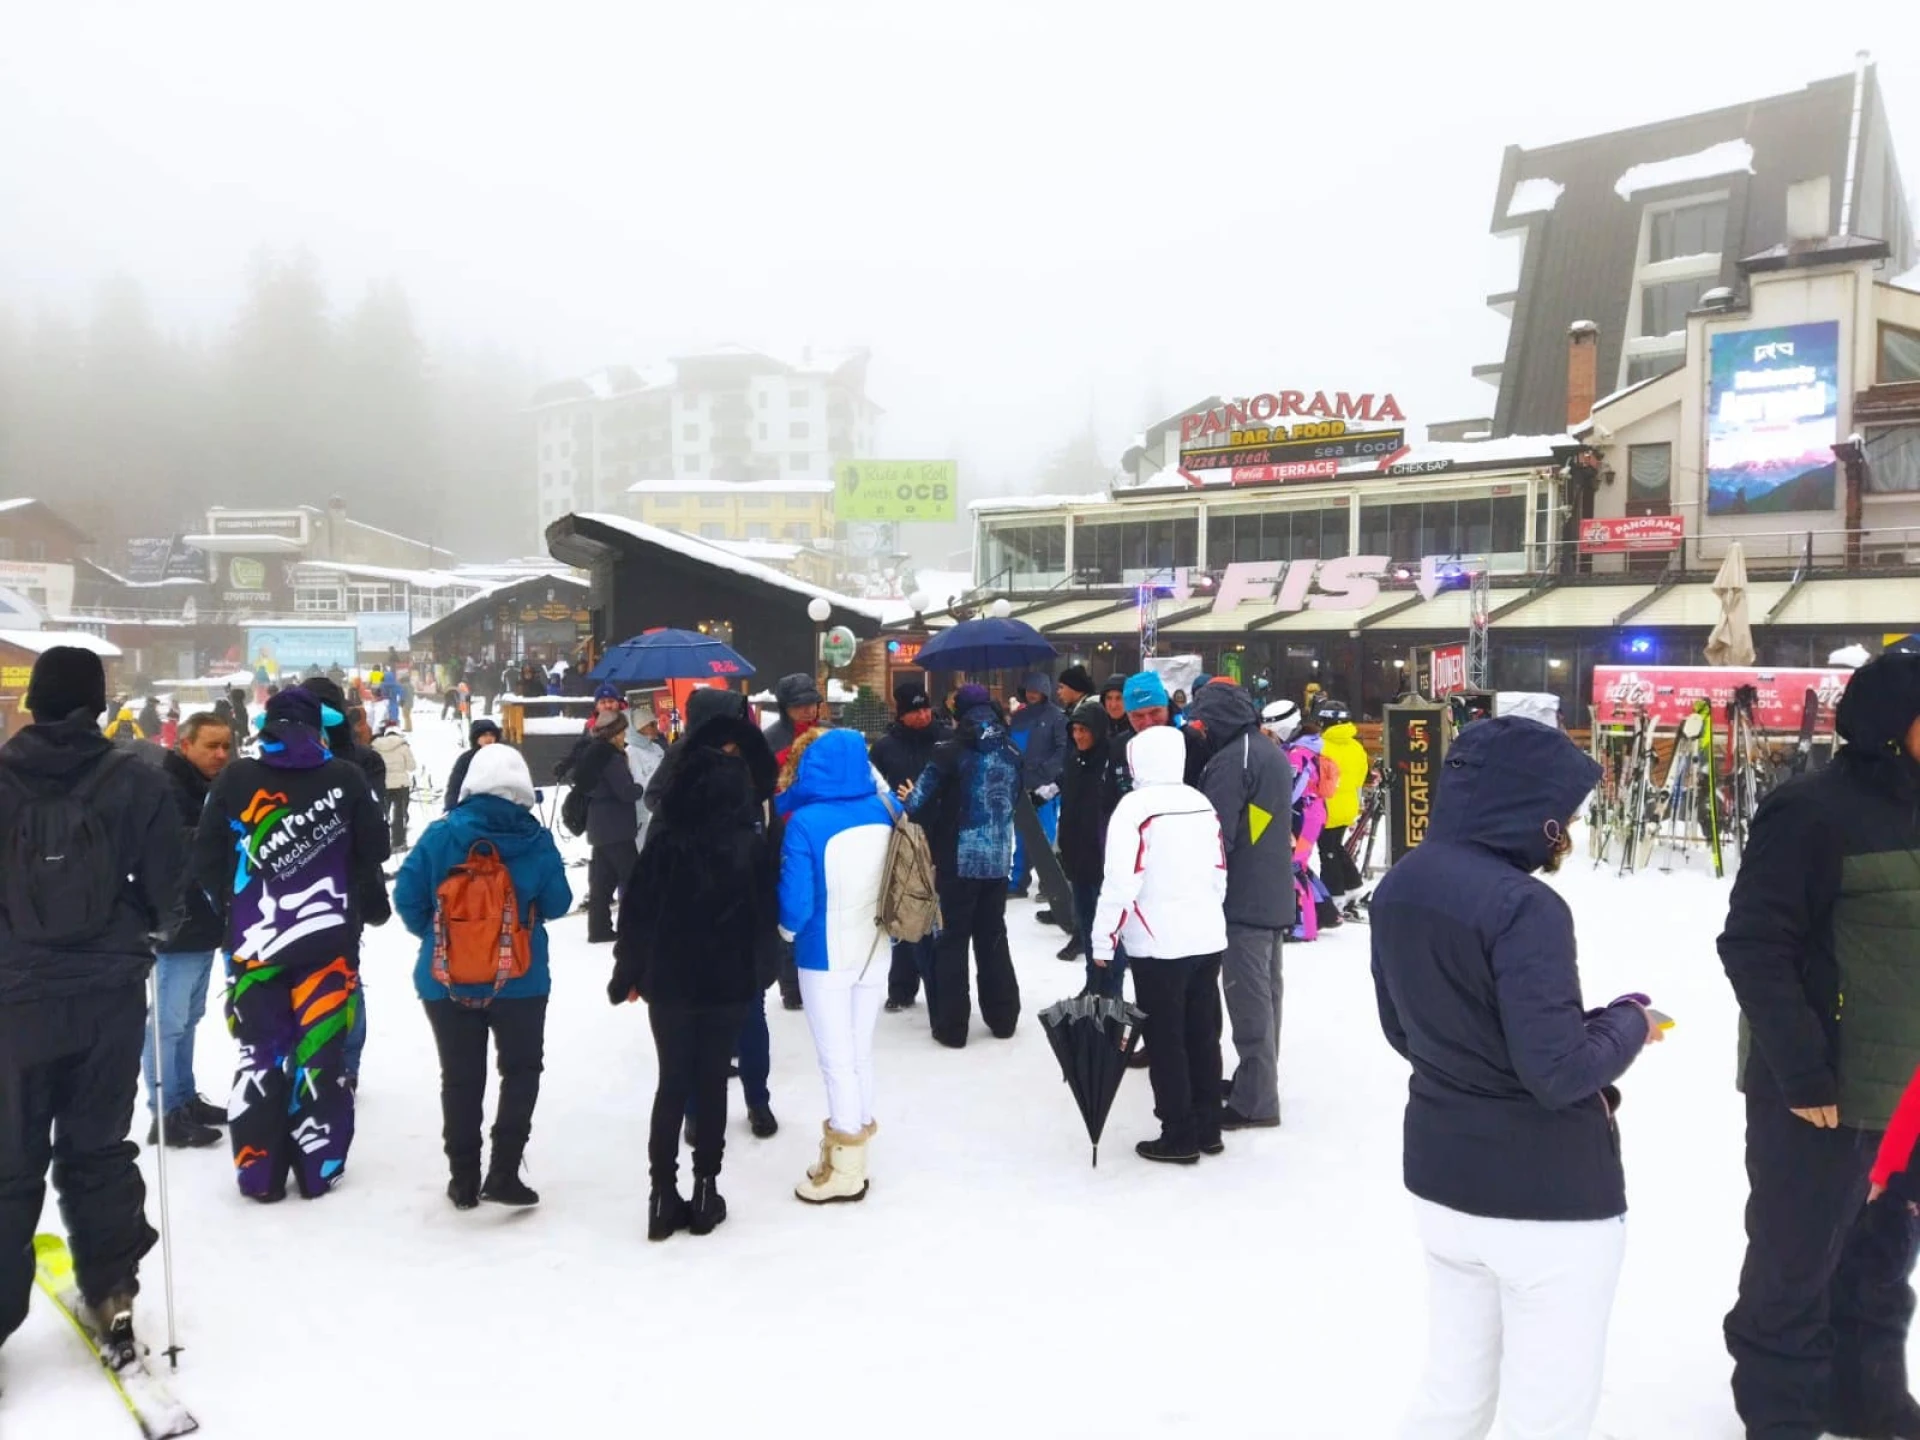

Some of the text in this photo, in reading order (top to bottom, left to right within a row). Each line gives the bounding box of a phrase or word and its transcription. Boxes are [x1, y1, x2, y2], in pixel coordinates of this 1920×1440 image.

[1180, 389, 1406, 443] PANORAMA
[1230, 420, 1345, 446] BAR & FOOD
[1314, 438, 1398, 458] sea food
[1183, 454, 1217, 470] Pizza
[1232, 449, 1270, 465] steak
[1272, 461, 1334, 478] TERRACE
[897, 483, 949, 501] OCB
[1615, 519, 1681, 535] PANORAMA
[1211, 554, 1393, 615] FIS
[1679, 687, 1709, 697] FEEL
[1711, 688, 1735, 698] THE
[270, 812, 342, 874] Mechi Chal
